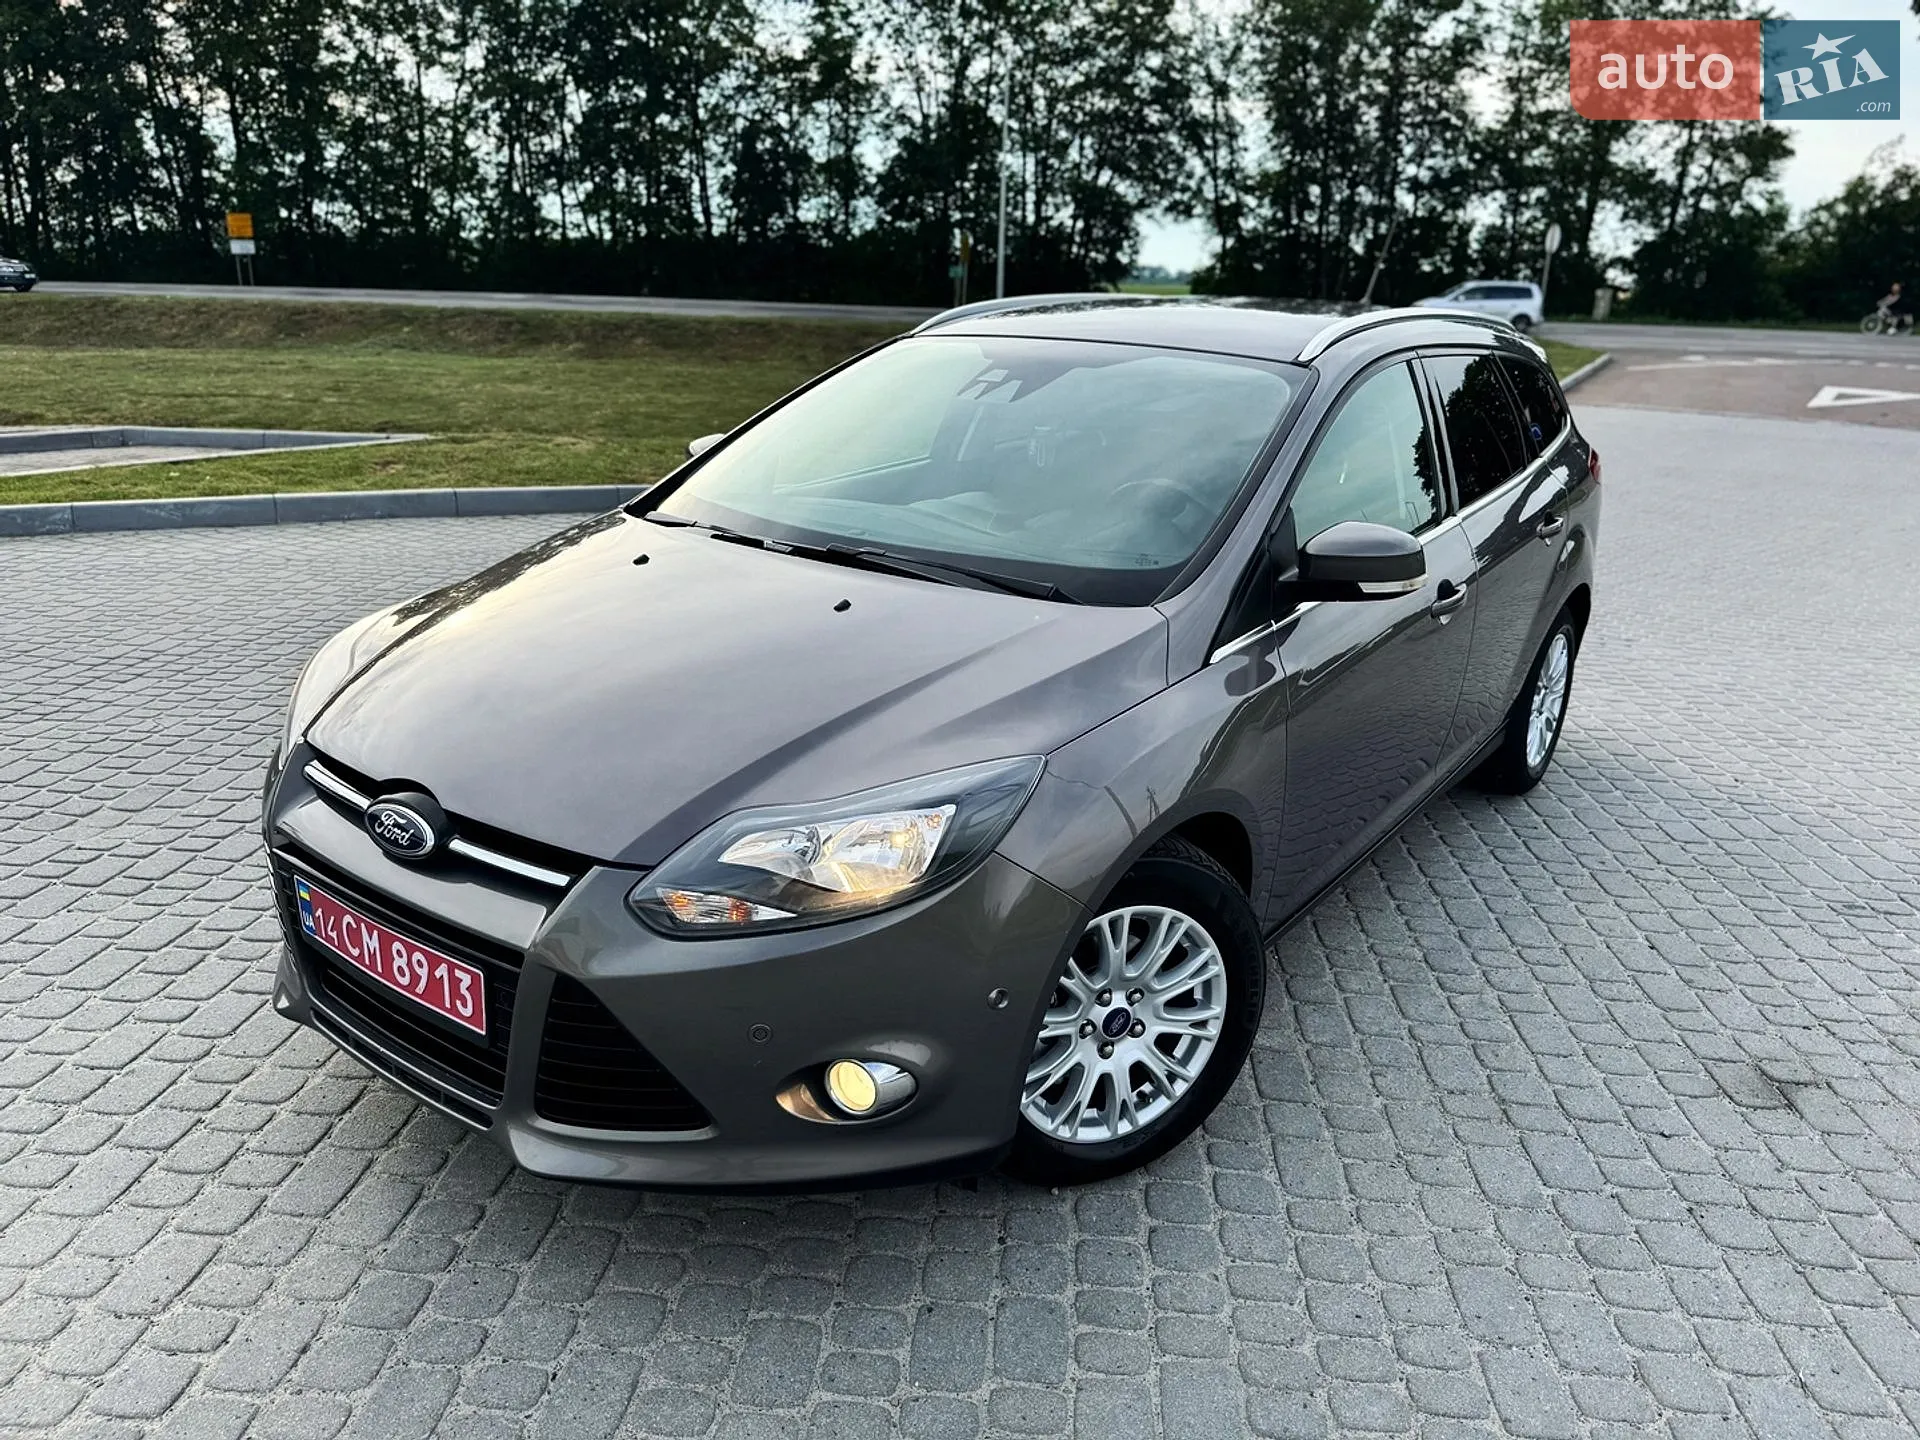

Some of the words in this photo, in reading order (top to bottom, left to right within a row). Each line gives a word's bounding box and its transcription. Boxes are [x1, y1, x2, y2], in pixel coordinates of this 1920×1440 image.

[374, 810, 415, 846] Ford
[302, 910, 316, 931] UA
[391, 940, 474, 1018] 8913
